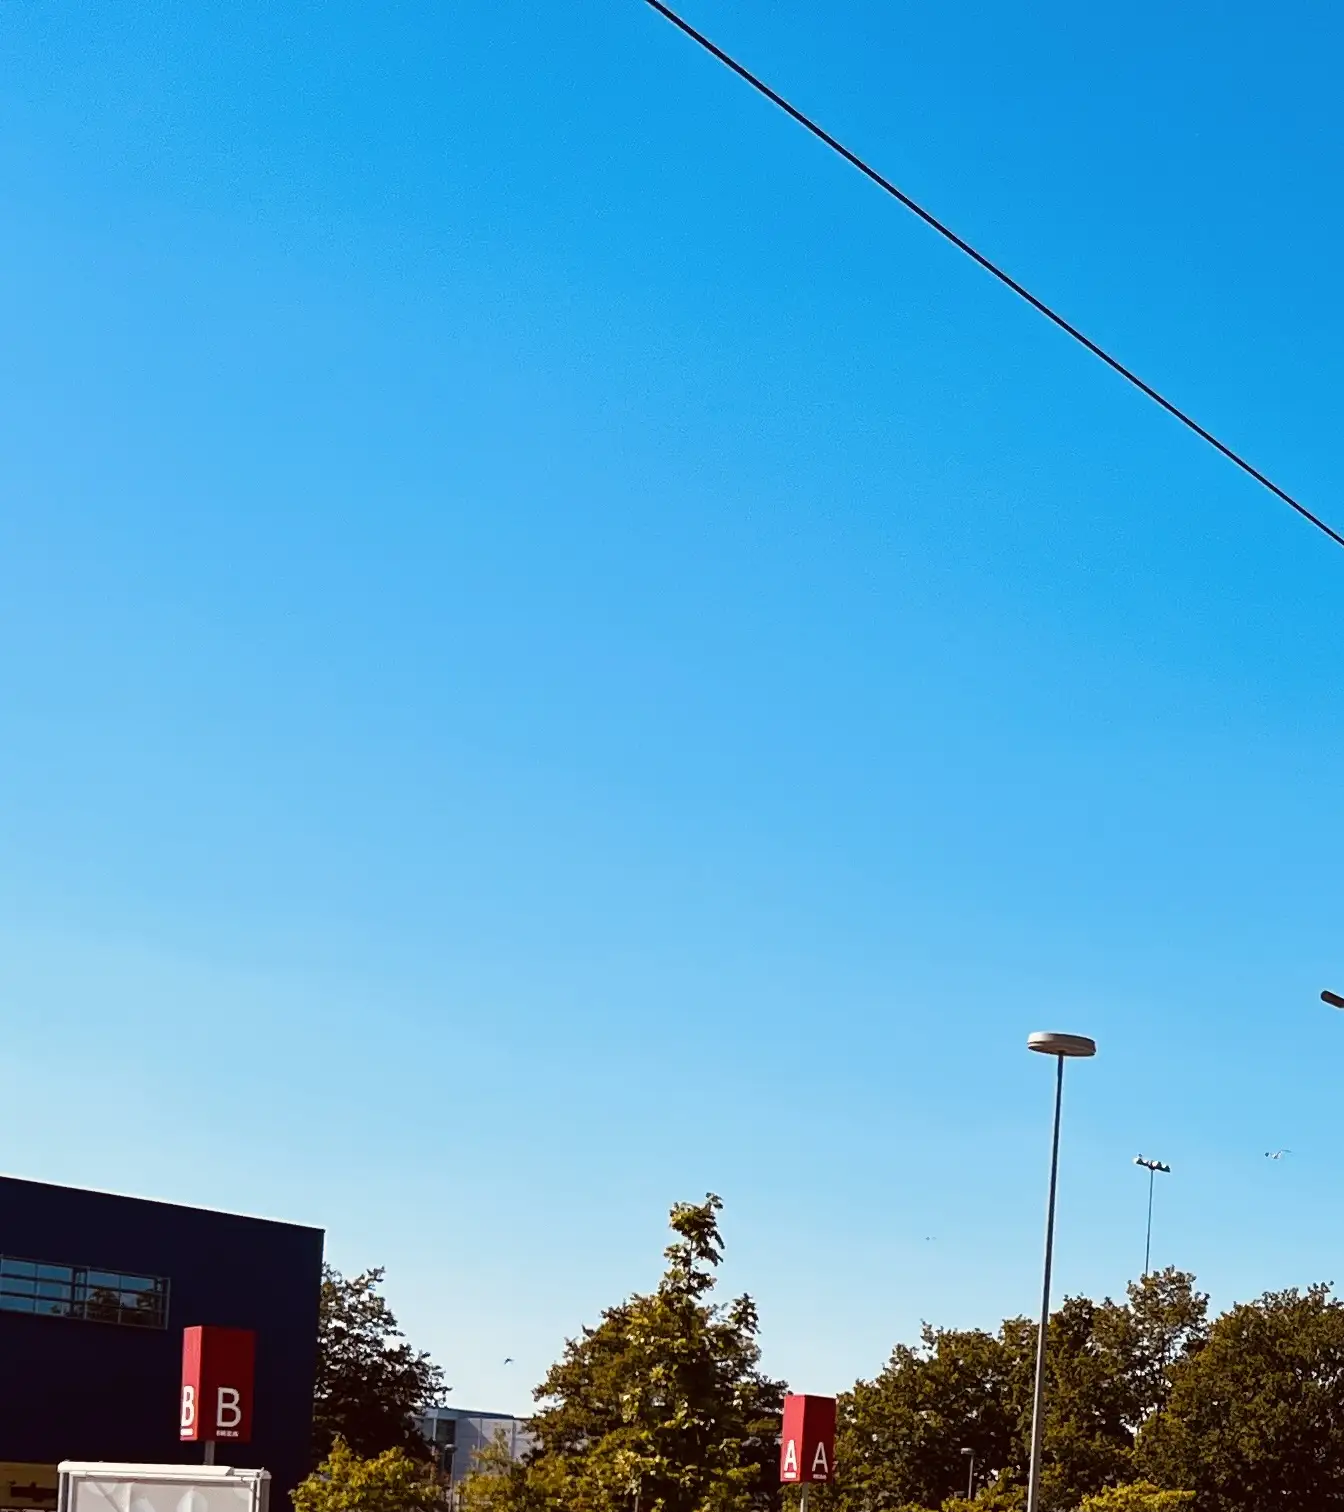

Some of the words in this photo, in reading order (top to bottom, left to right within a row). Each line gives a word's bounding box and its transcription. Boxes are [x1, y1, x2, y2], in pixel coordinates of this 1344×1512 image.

[181, 1385, 194, 1427] B
[216, 1386, 241, 1427] B
[783, 1439, 797, 1472] A
[811, 1441, 828, 1473] A
